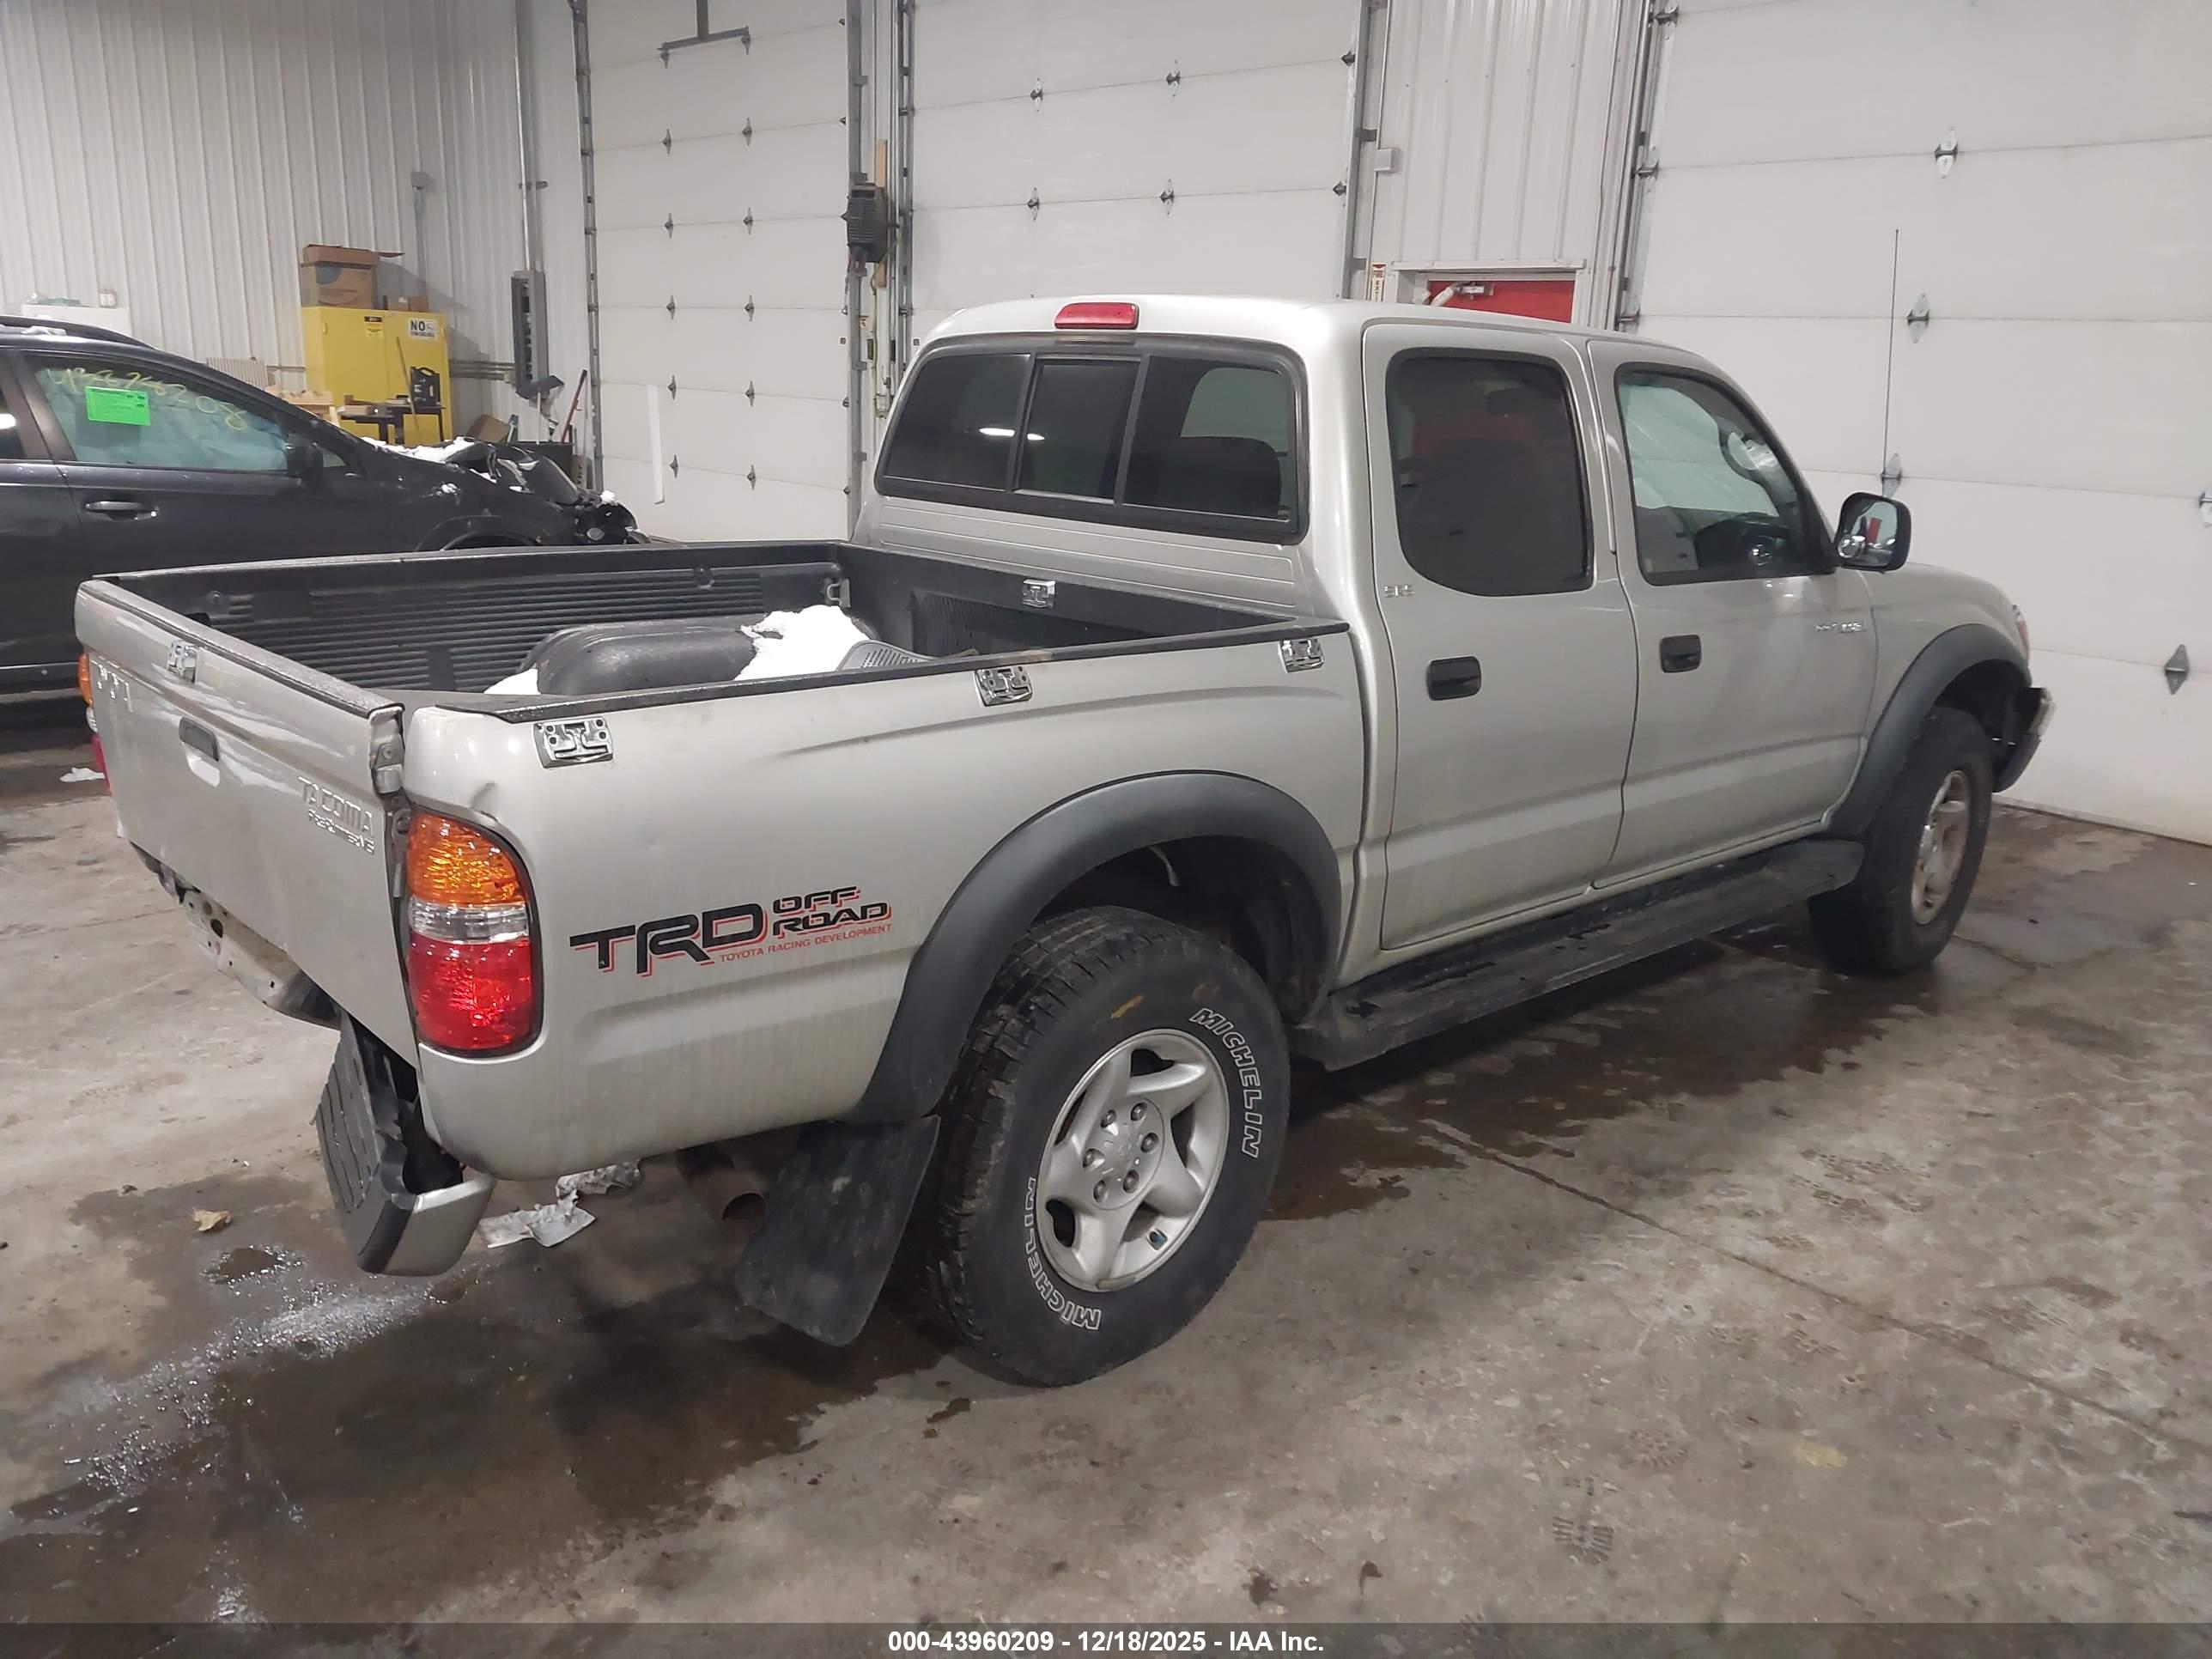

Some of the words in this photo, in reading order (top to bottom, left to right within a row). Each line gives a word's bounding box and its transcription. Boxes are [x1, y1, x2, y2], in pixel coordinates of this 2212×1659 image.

[410, 320, 426, 331] NO
[298, 775, 374, 838] TACOMA
[773, 886, 860, 916] OFF
[773, 902, 892, 939] ROAD
[569, 903, 768, 976] TRD
[720, 948, 764, 963] TOYOTA
[768, 938, 811, 955] RACING
[814, 923, 892, 945] DEVELOPMENT
[1188, 1007, 1263, 1158] MICHELIN
[1024, 1176, 1102, 1330] MICHELIN
